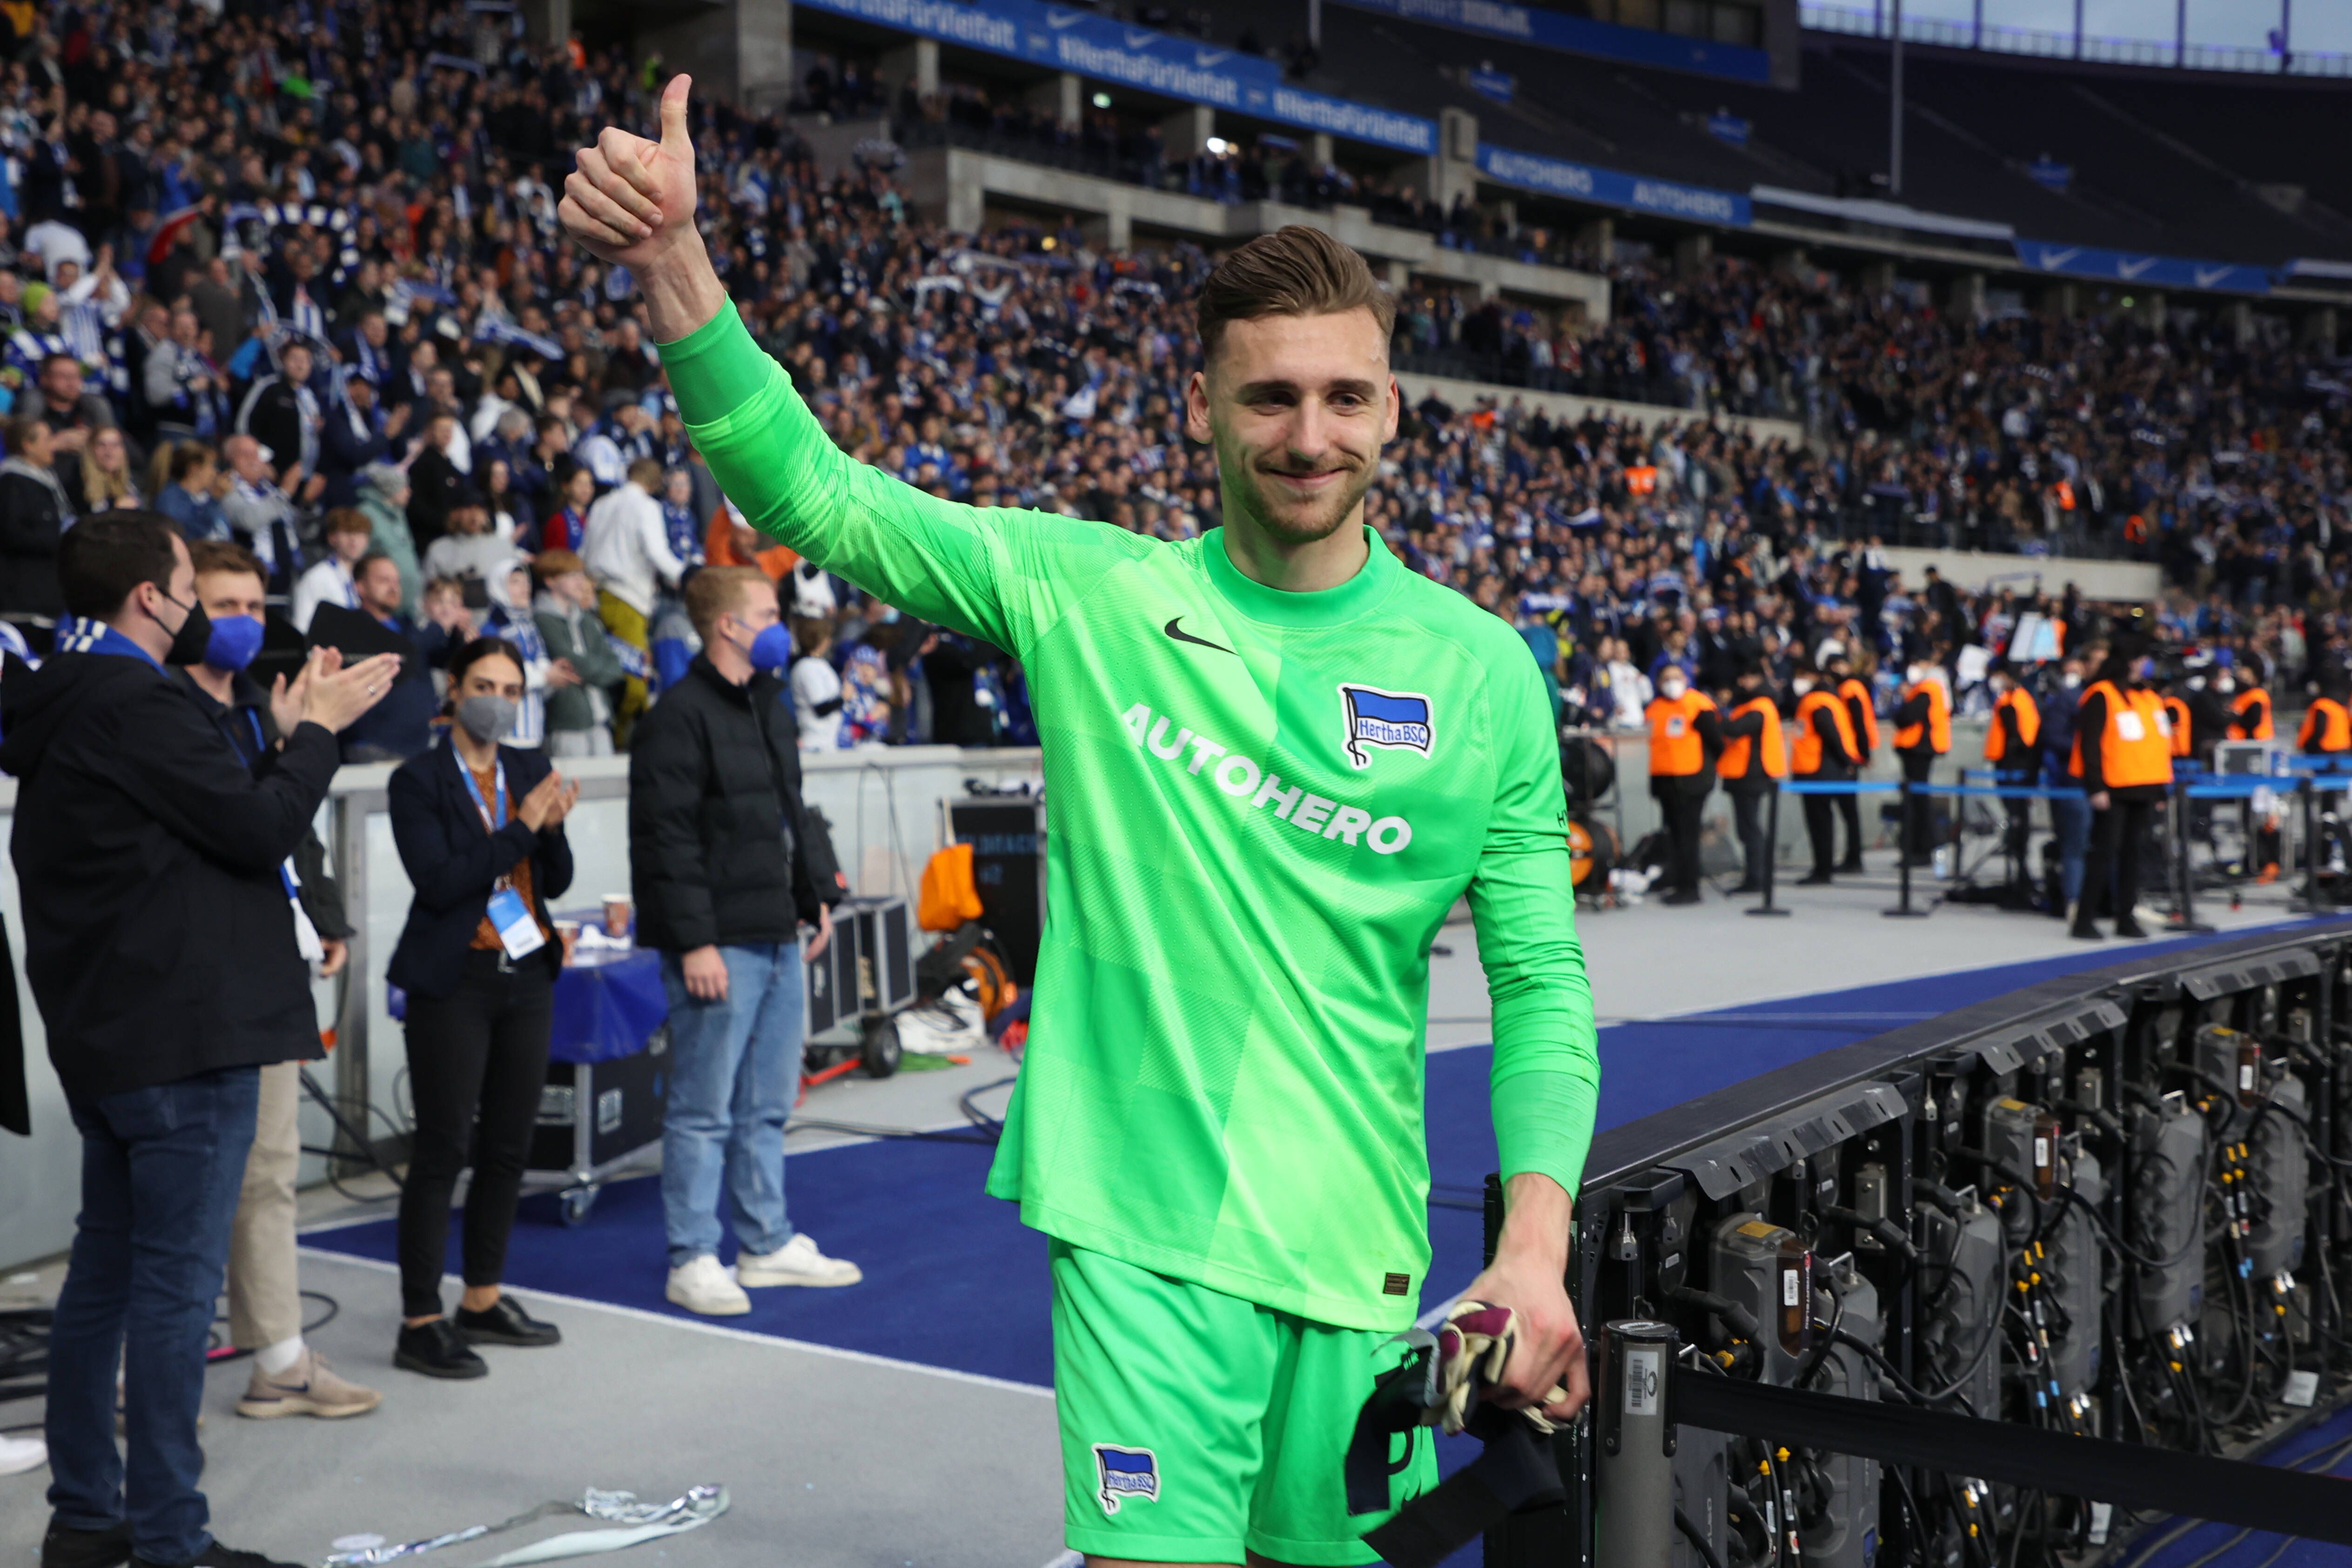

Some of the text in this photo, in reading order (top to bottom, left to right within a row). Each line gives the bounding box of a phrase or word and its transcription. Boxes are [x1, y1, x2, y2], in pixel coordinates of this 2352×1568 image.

[1490, 150, 1593, 194] AUTOHERO
[1633, 181, 1733, 220] AUTOHERO
[1360, 720, 1426, 744] Hertha BSC
[1122, 702, 1412, 855] AUTOHERO
